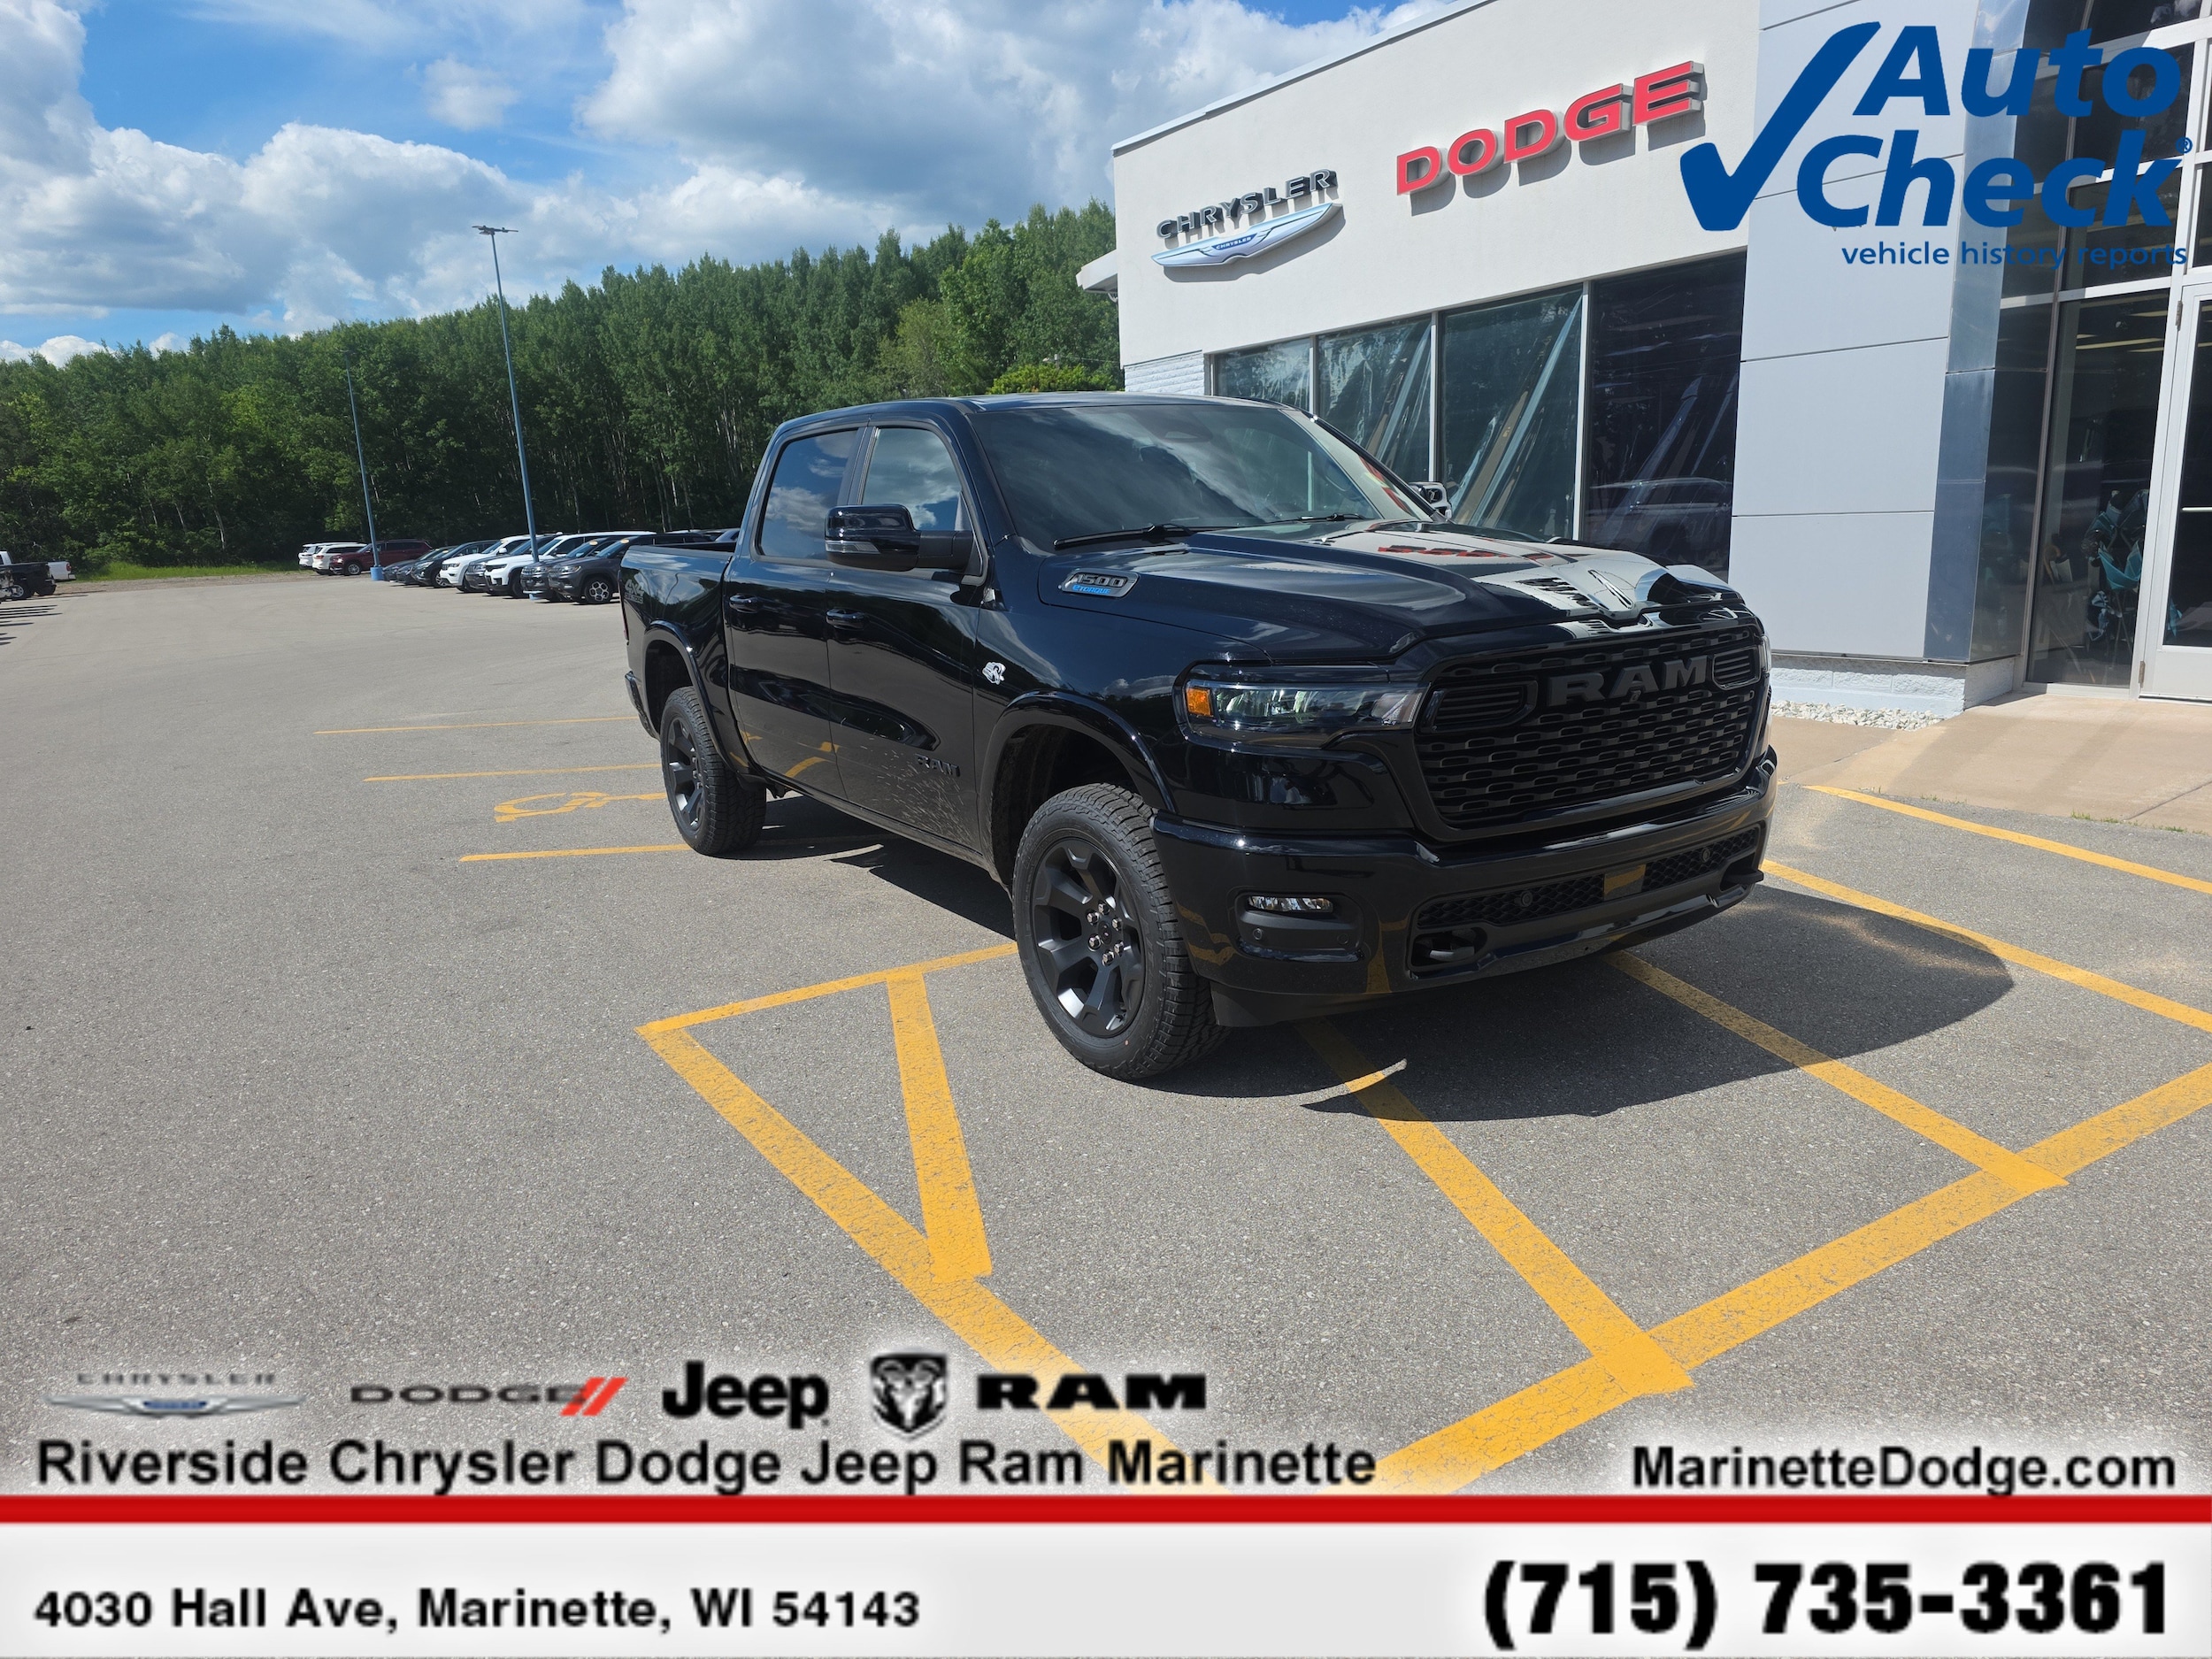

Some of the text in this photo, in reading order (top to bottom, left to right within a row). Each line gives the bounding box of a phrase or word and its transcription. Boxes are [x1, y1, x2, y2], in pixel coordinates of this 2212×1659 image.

[1396, 60, 1704, 196] DODGE
[1156, 168, 1338, 238] CHRYSLER
[1216, 236, 1252, 250] CHRYSLER
[1548, 655, 1709, 707] RAM
[915, 753, 961, 777] RAM
